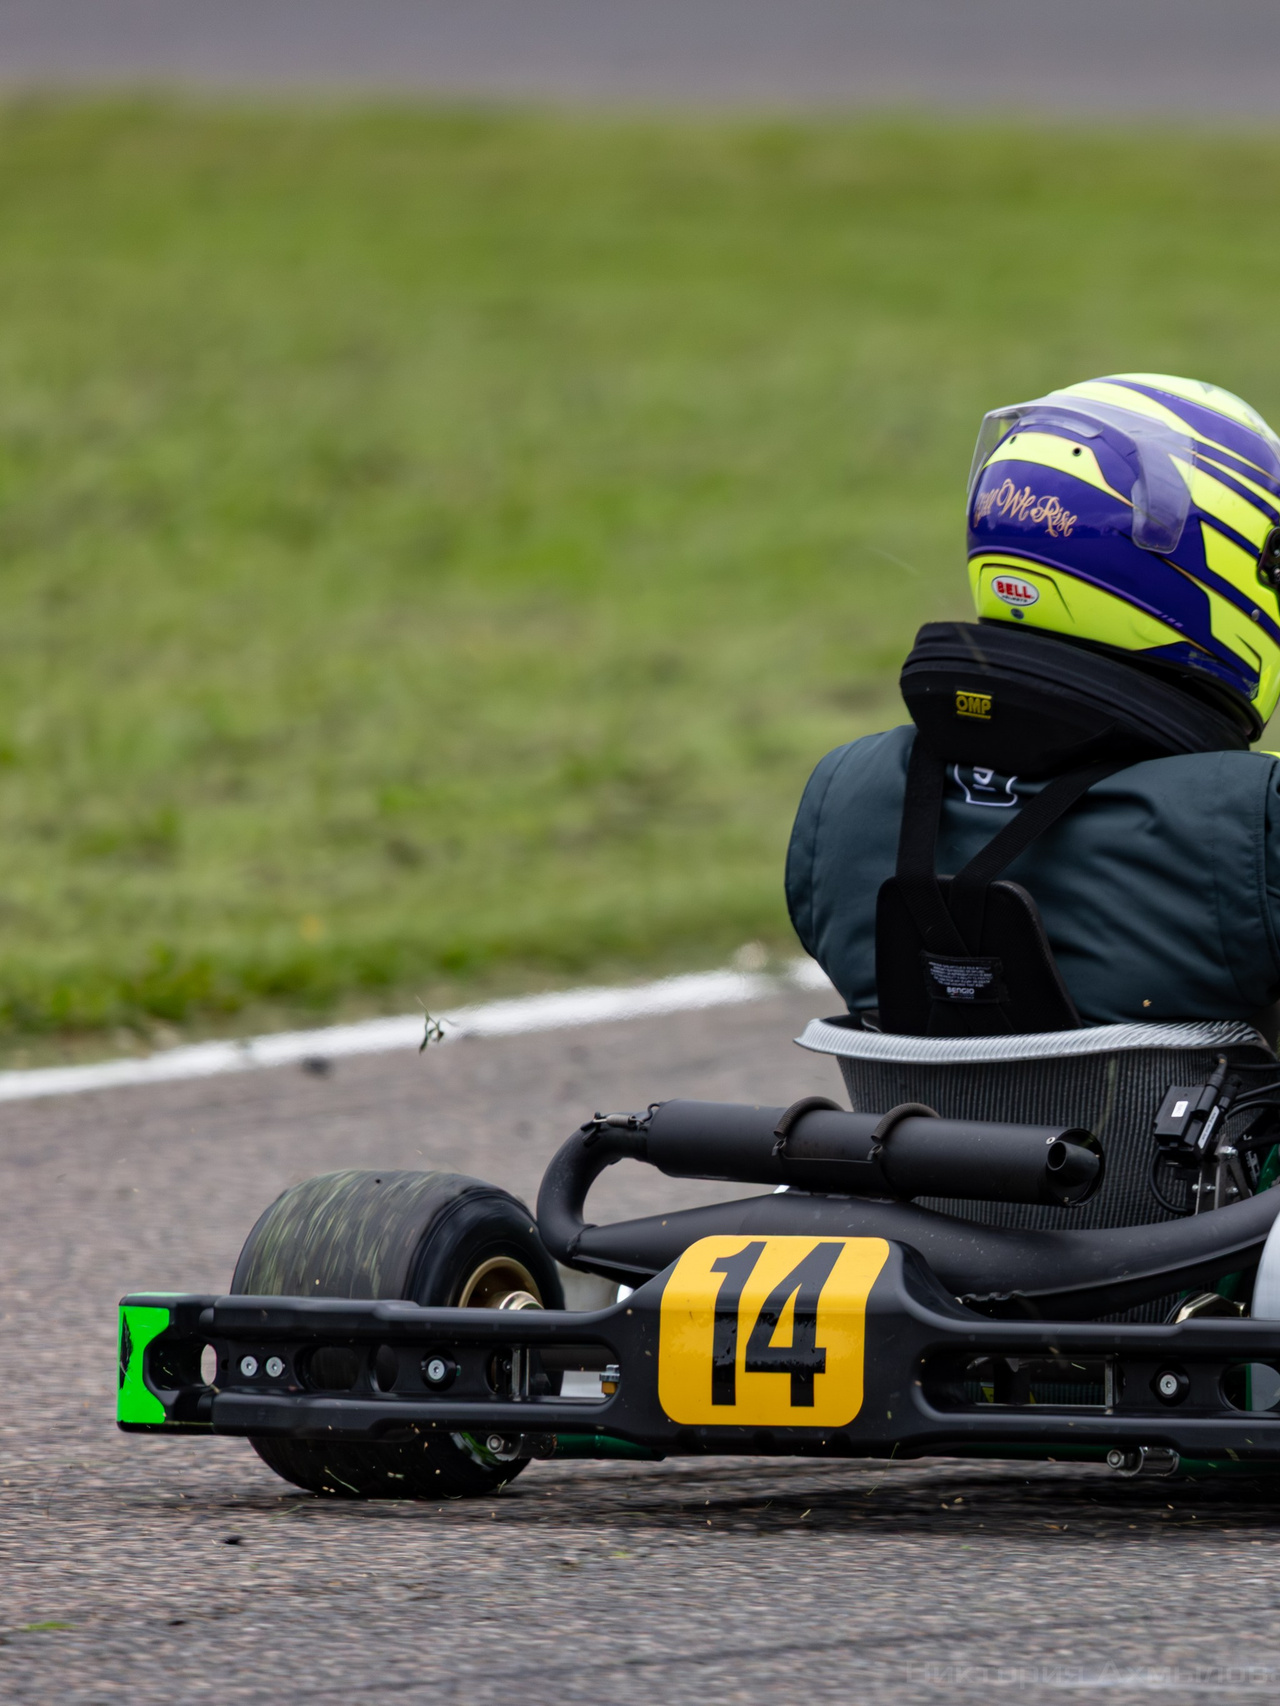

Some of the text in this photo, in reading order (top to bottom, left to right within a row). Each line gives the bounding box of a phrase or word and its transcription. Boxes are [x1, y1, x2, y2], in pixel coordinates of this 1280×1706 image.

[996, 580, 1032, 599] BELL
[956, 695, 991, 715] OMP
[710, 1241, 846, 1407] 14
